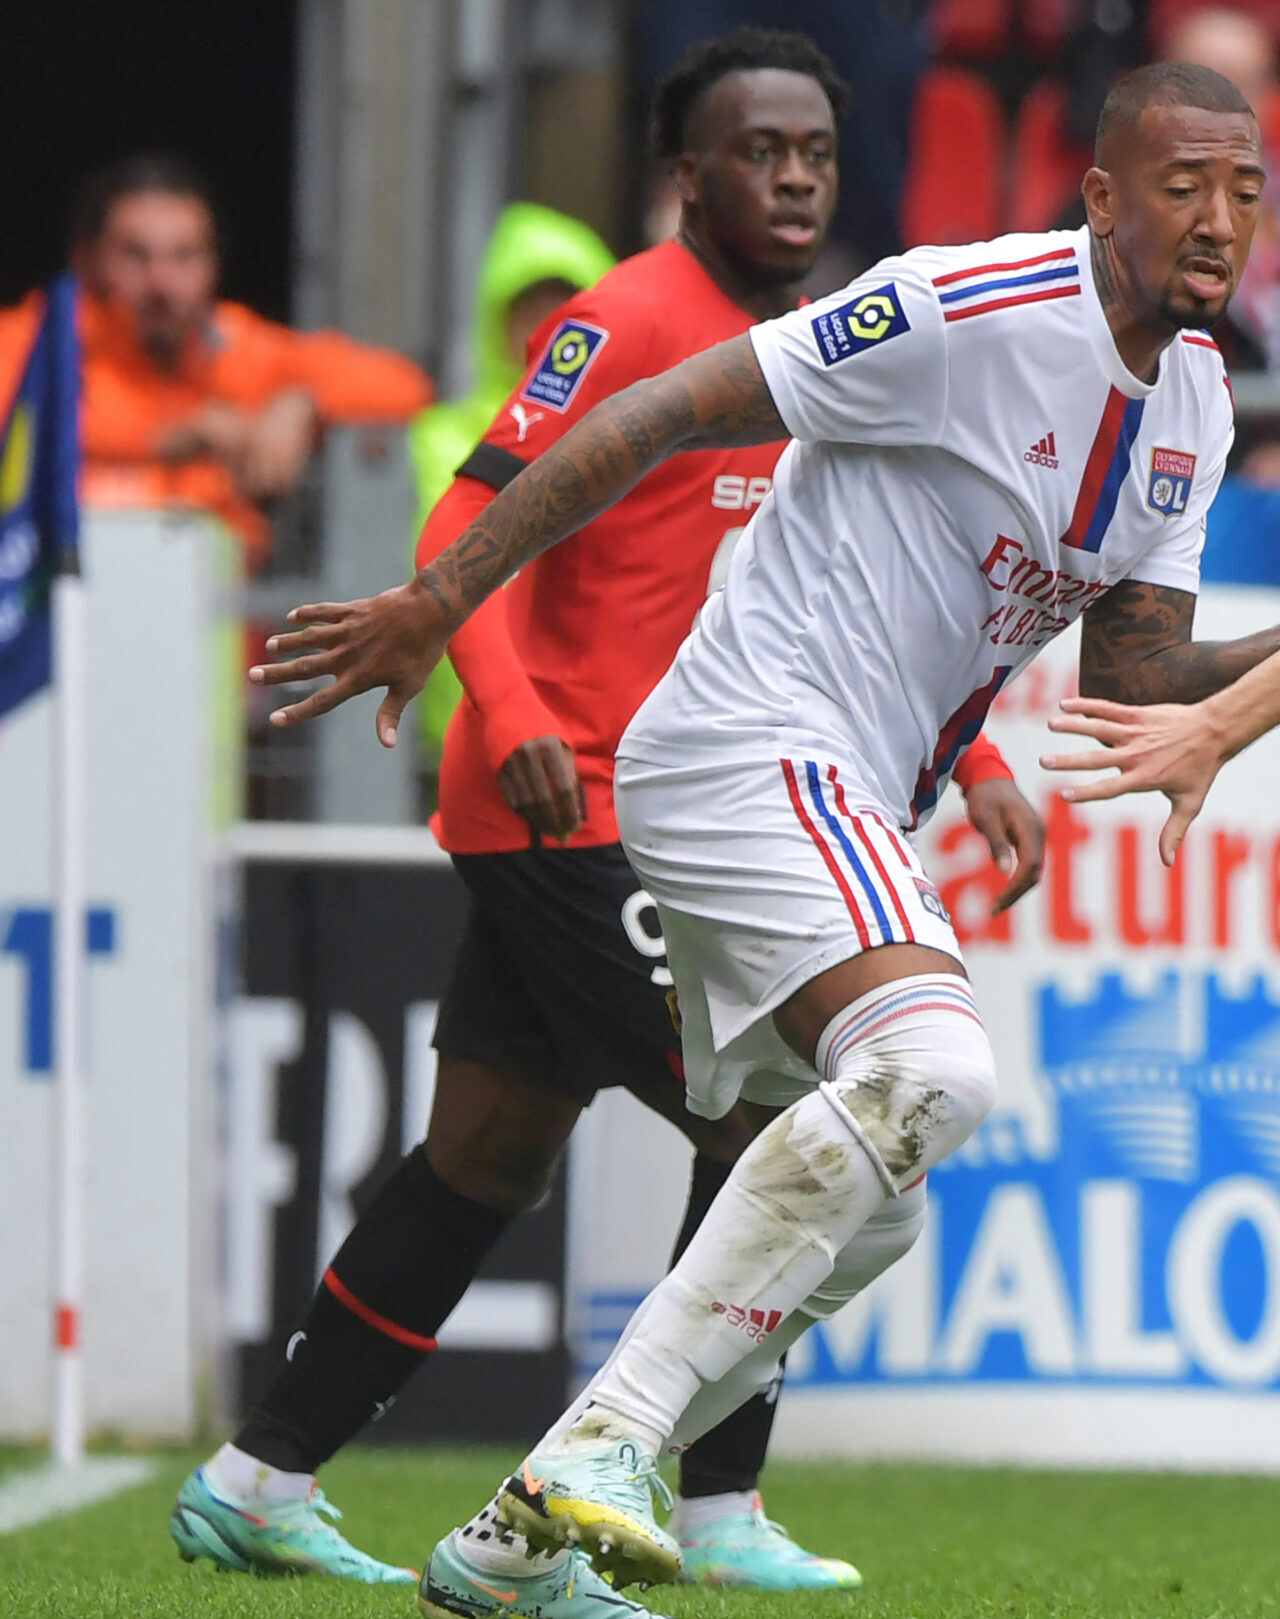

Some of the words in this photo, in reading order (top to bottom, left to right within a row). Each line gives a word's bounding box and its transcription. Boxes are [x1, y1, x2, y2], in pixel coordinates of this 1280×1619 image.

[830, 312, 848, 345] LIGUE
[1023, 451, 1059, 470] adidas
[1154, 450, 1195, 467] OLYMPIQUE
[1154, 460, 1192, 476] LYONNAIS
